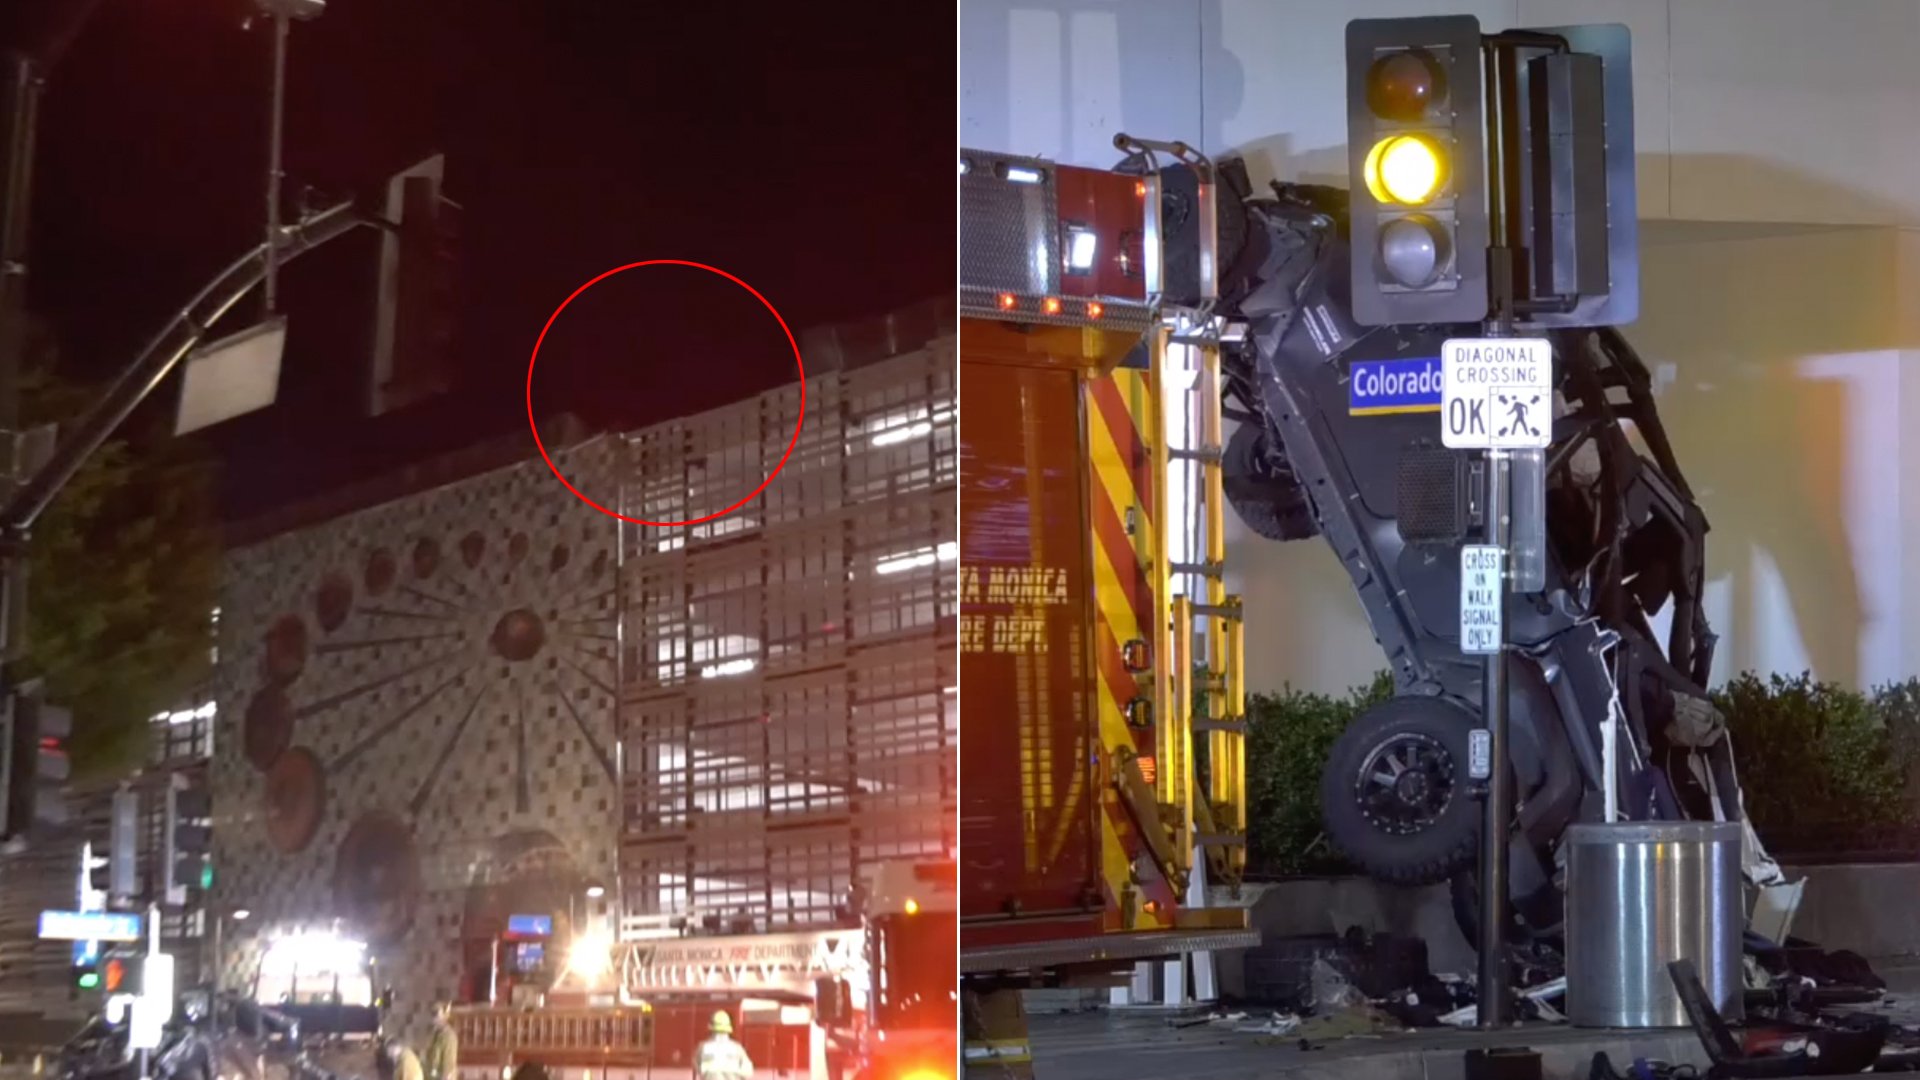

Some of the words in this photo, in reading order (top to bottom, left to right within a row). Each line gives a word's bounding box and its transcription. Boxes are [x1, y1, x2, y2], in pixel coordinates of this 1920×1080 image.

[1456, 347, 1537, 363] DIAGONAL
[1354, 361, 1443, 397] Colorado
[1457, 367, 1538, 383] CROSSING
[1450, 397, 1486, 435] OK
[1465, 552, 1497, 569] CROSS
[987, 566, 1068, 604] MONICA
[1474, 573, 1487, 587] ON
[1468, 589, 1493, 606] WALK
[1463, 609, 1498, 625] SIGNAL
[992, 616, 1049, 653] DEPT.
[1468, 628, 1493, 645] ONLY
[754, 943, 819, 961] DEPARTMENT
